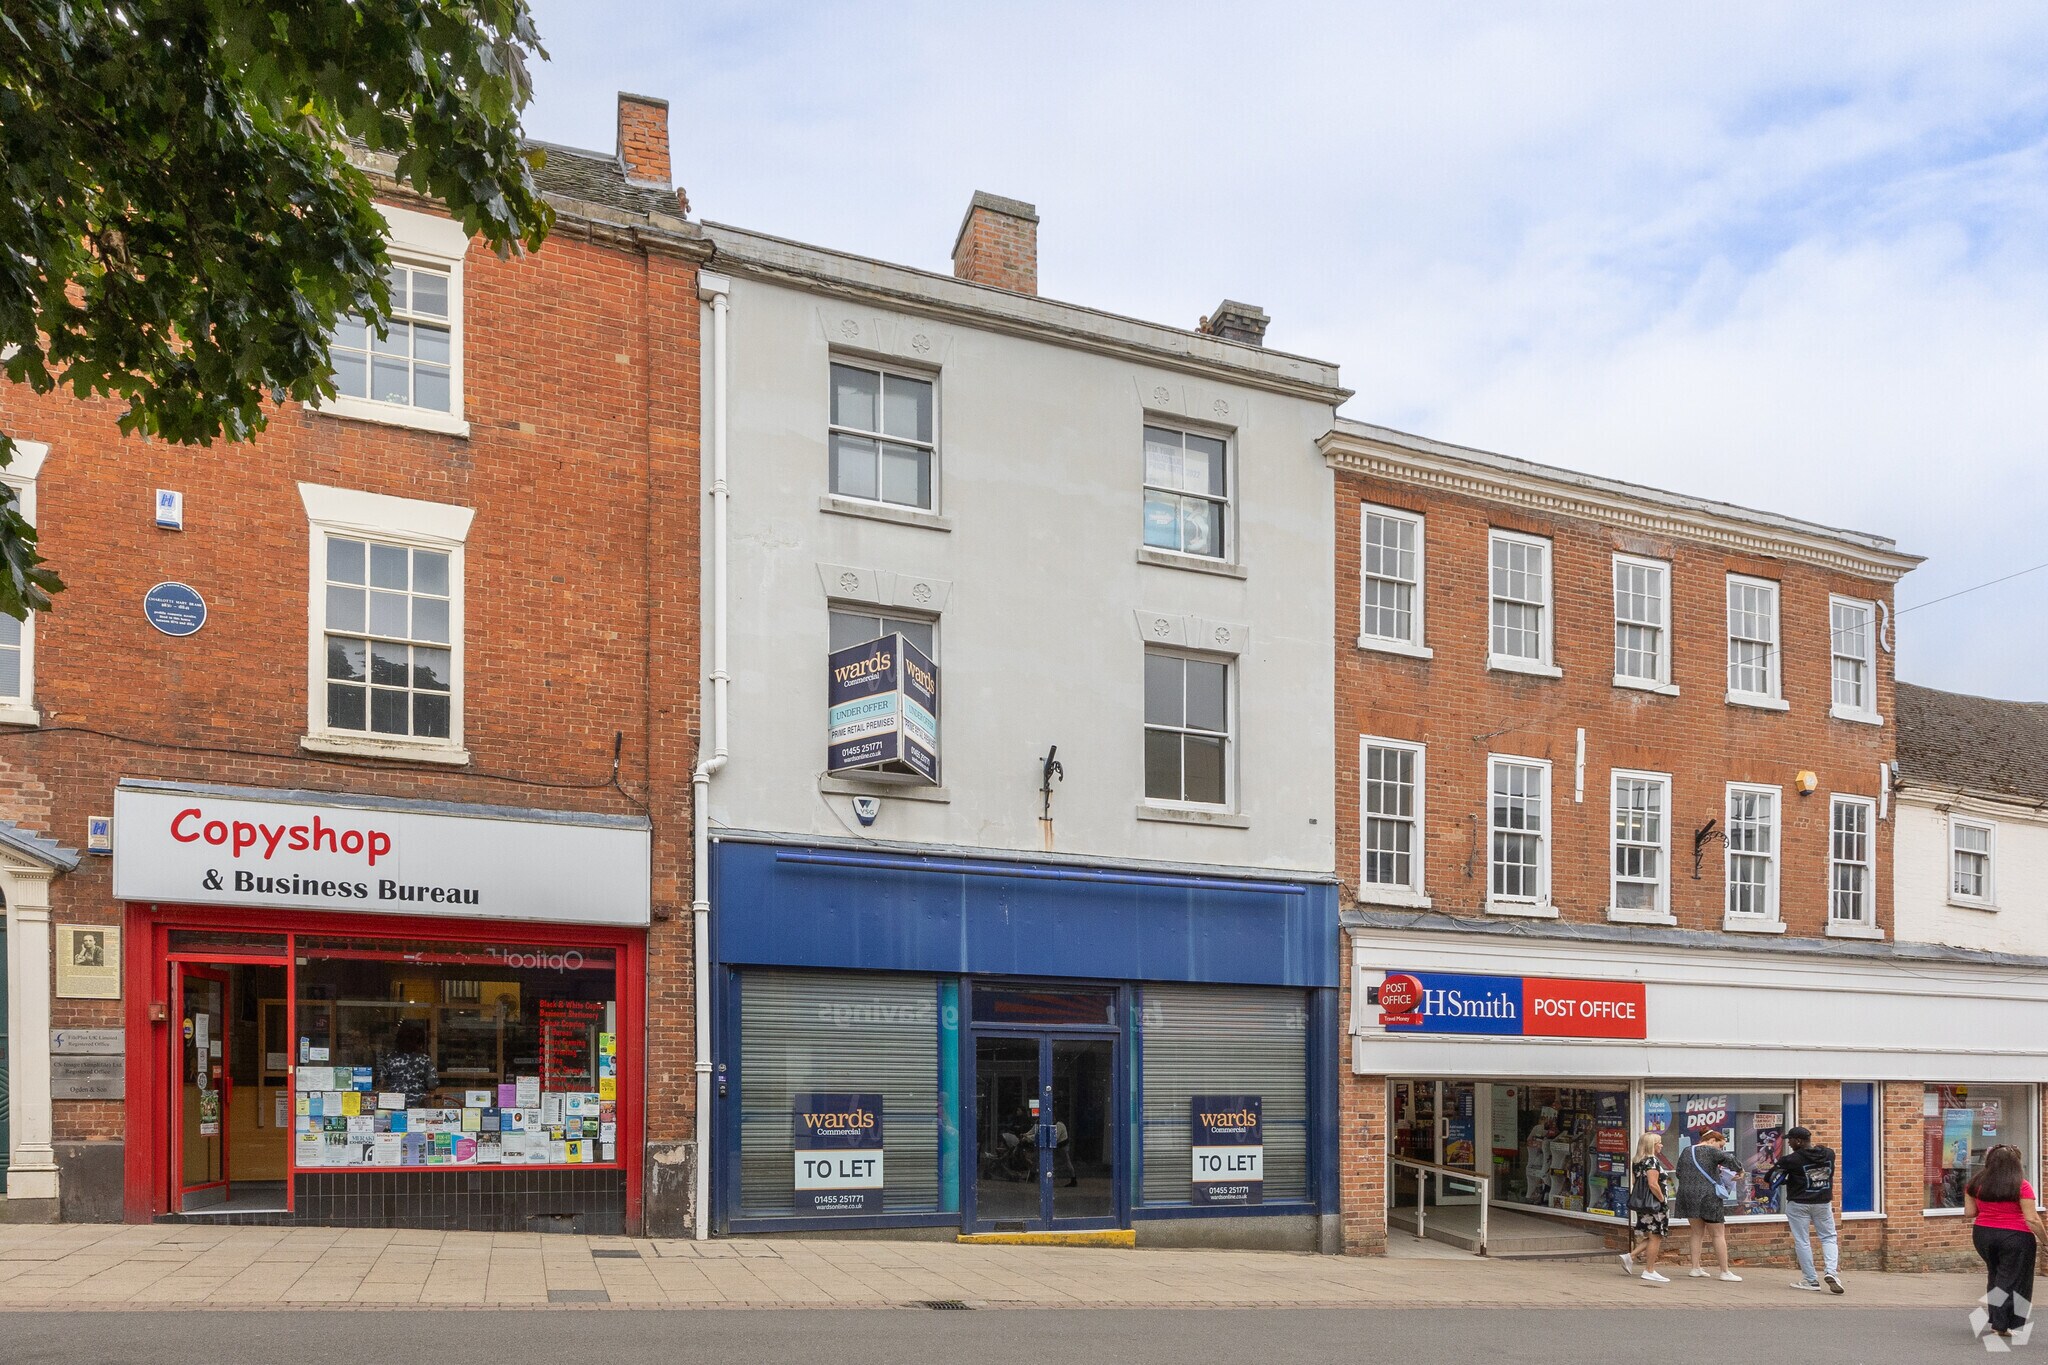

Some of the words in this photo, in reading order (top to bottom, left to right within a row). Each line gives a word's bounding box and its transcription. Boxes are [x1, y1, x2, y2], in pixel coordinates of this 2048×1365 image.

[835, 651, 891, 683] wards
[843, 672, 879, 688] Commercial
[905, 658, 935, 695] wards
[836, 706, 861, 720] UNDER
[862, 700, 888, 714] OFFER
[831, 728, 846, 739] PRIME
[847, 723, 865, 735] RETAIL
[866, 717, 894, 730] PREMISES
[842, 745, 861, 757] 01455
[862, 741, 883, 753] 251771
[843, 750, 882, 763] wardsonline.co.uk
[170, 808, 391, 866] Copyshop
[202, 868, 224, 890] &
[234, 869, 368, 899] Business
[378, 878, 480, 905] Bureau
[1385, 982, 1408, 993] POST
[539, 1000, 556, 1009] Black
[566, 1001, 583, 1009] White
[1382, 994, 1412, 1005] OFFICE
[1414, 989, 1516, 1019] HSmith
[1534, 998, 1577, 1018] POST
[1579, 1000, 1636, 1020] OFFICE
[561, 1020, 585, 1029] Copying
[1686, 1095, 1728, 1113] PRICE
[803, 1109, 875, 1128] wards
[1200, 1109, 1256, 1127] wards
[1687, 1110, 1726, 1128] DROP
[817, 1128, 861, 1136] Commercial
[804, 1160, 832, 1178] TO
[839, 1160, 876, 1178] LET
[1199, 1155, 1222, 1171] TO
[1228, 1155, 1257, 1171] LET
[814, 1195, 837, 1203] 01455
[839, 1195, 864, 1203] 251771
[1228, 1186, 1249, 1194] 251771
[816, 1203, 862, 1211] wardsonline.co.uk
